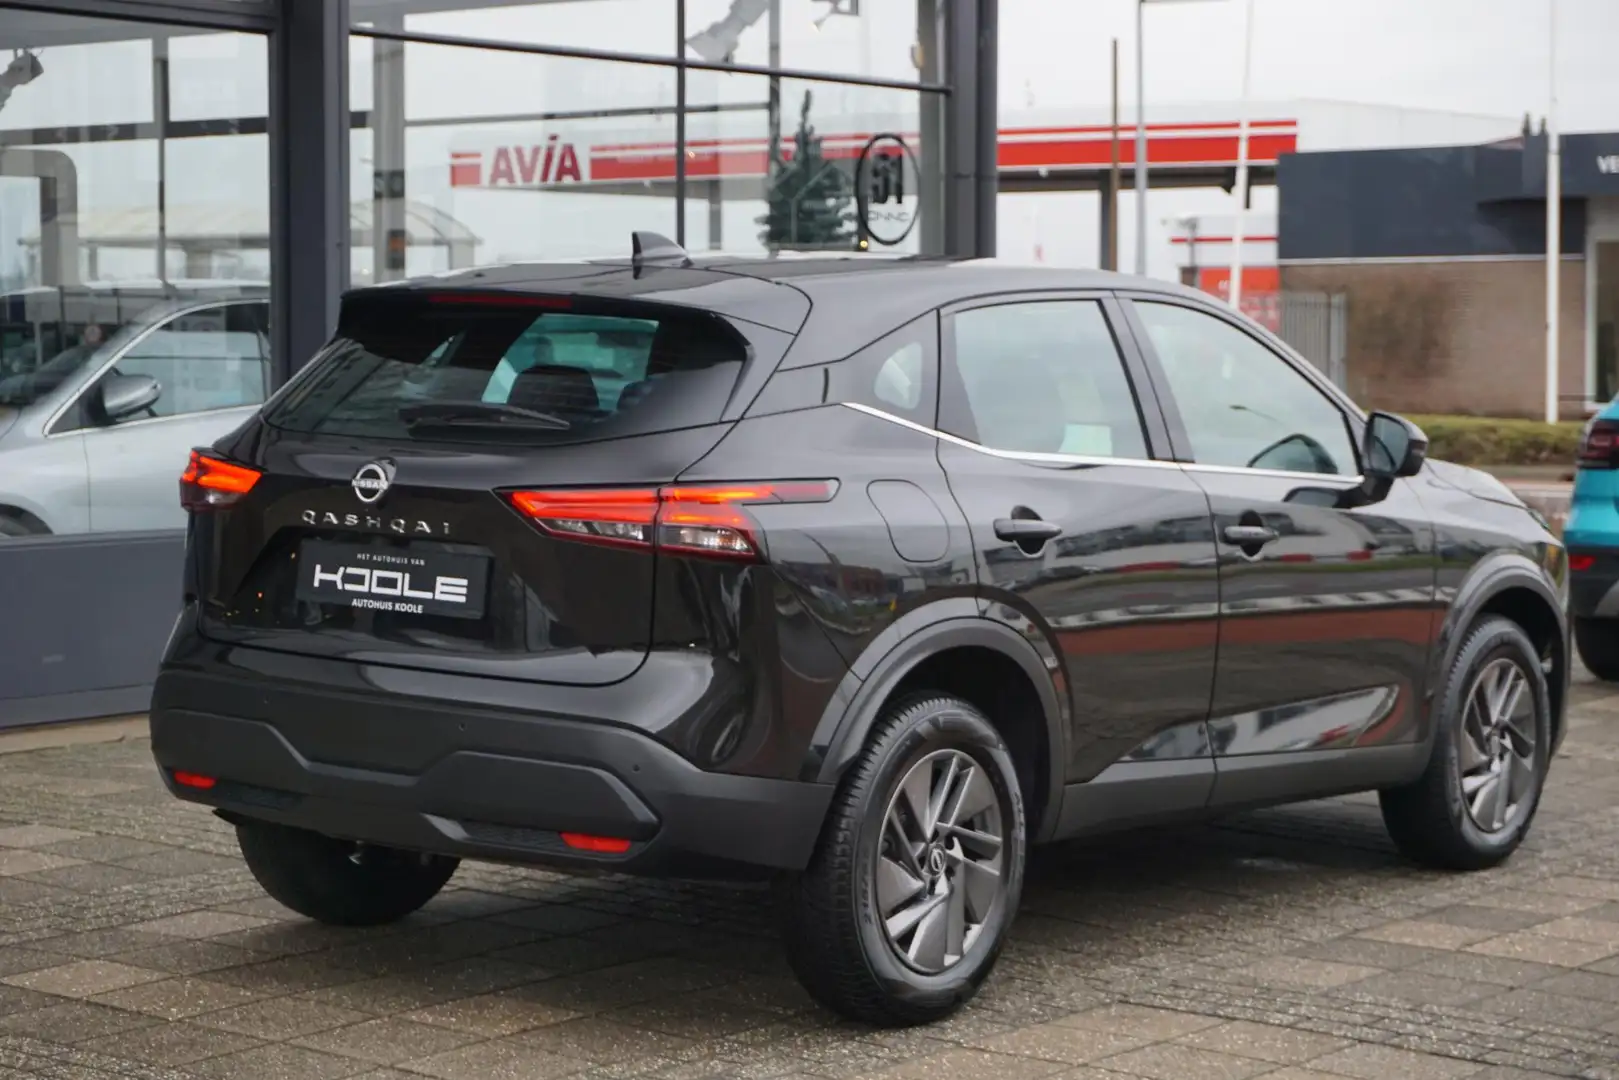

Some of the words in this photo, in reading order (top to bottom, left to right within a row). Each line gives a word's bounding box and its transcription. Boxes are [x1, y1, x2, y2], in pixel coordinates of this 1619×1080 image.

[352, 479, 388, 490] NISSAN
[302, 510, 450, 535] QASHQAI
[357, 553, 370, 561] HET
[373, 555, 408, 564] AUTOHUIS
[410, 558, 425, 566] VAN
[313, 564, 468, 603] KOOLE
[352, 598, 393, 610] AUTOHUIS
[395, 603, 424, 614] KOOLE
